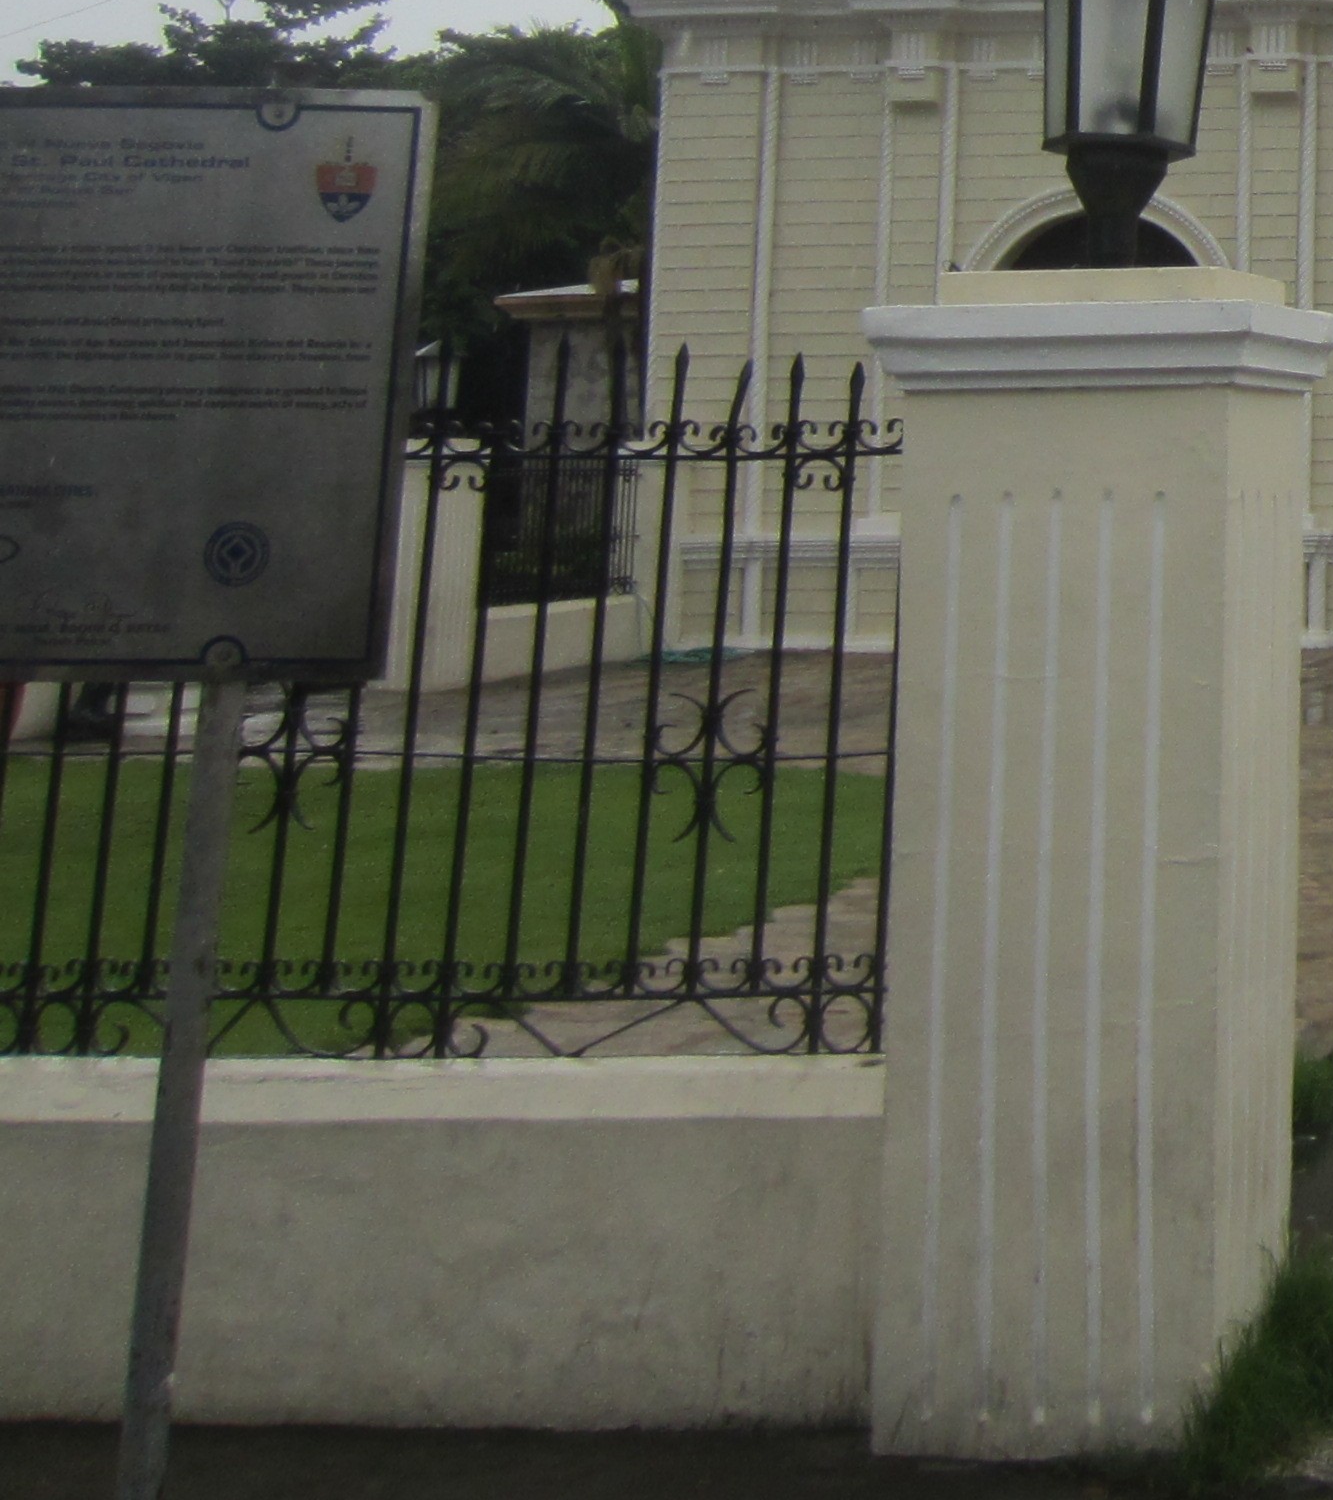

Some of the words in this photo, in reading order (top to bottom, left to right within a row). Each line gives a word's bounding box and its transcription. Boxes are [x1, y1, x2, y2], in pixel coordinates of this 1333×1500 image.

[119, 137, 205, 151] Segovia
[60, 154, 114, 168] Paul
[123, 155, 250, 169] Cathedral
